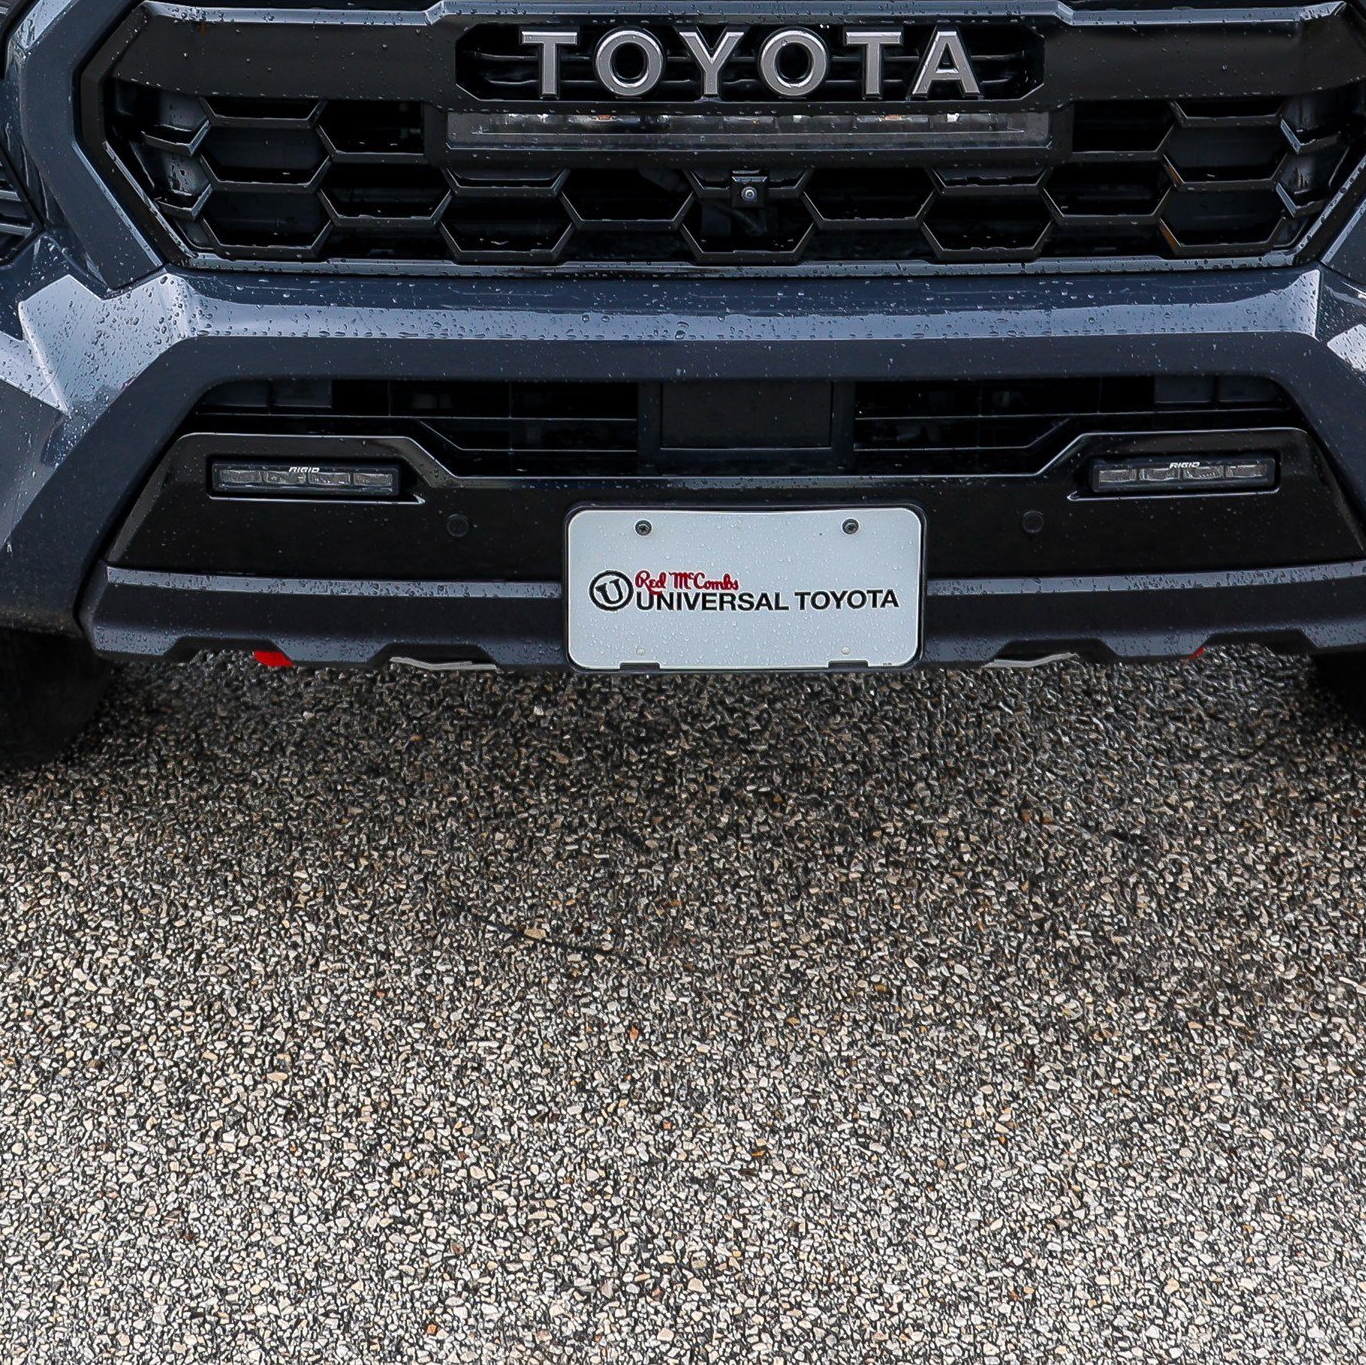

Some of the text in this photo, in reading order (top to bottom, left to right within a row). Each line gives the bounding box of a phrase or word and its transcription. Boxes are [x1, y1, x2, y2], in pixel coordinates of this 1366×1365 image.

[520, 27, 983, 99] TOYOTA
[635, 569, 739, 596] Red McCombs
[636, 588, 900, 612] UNIVERSAL TOYOTA
